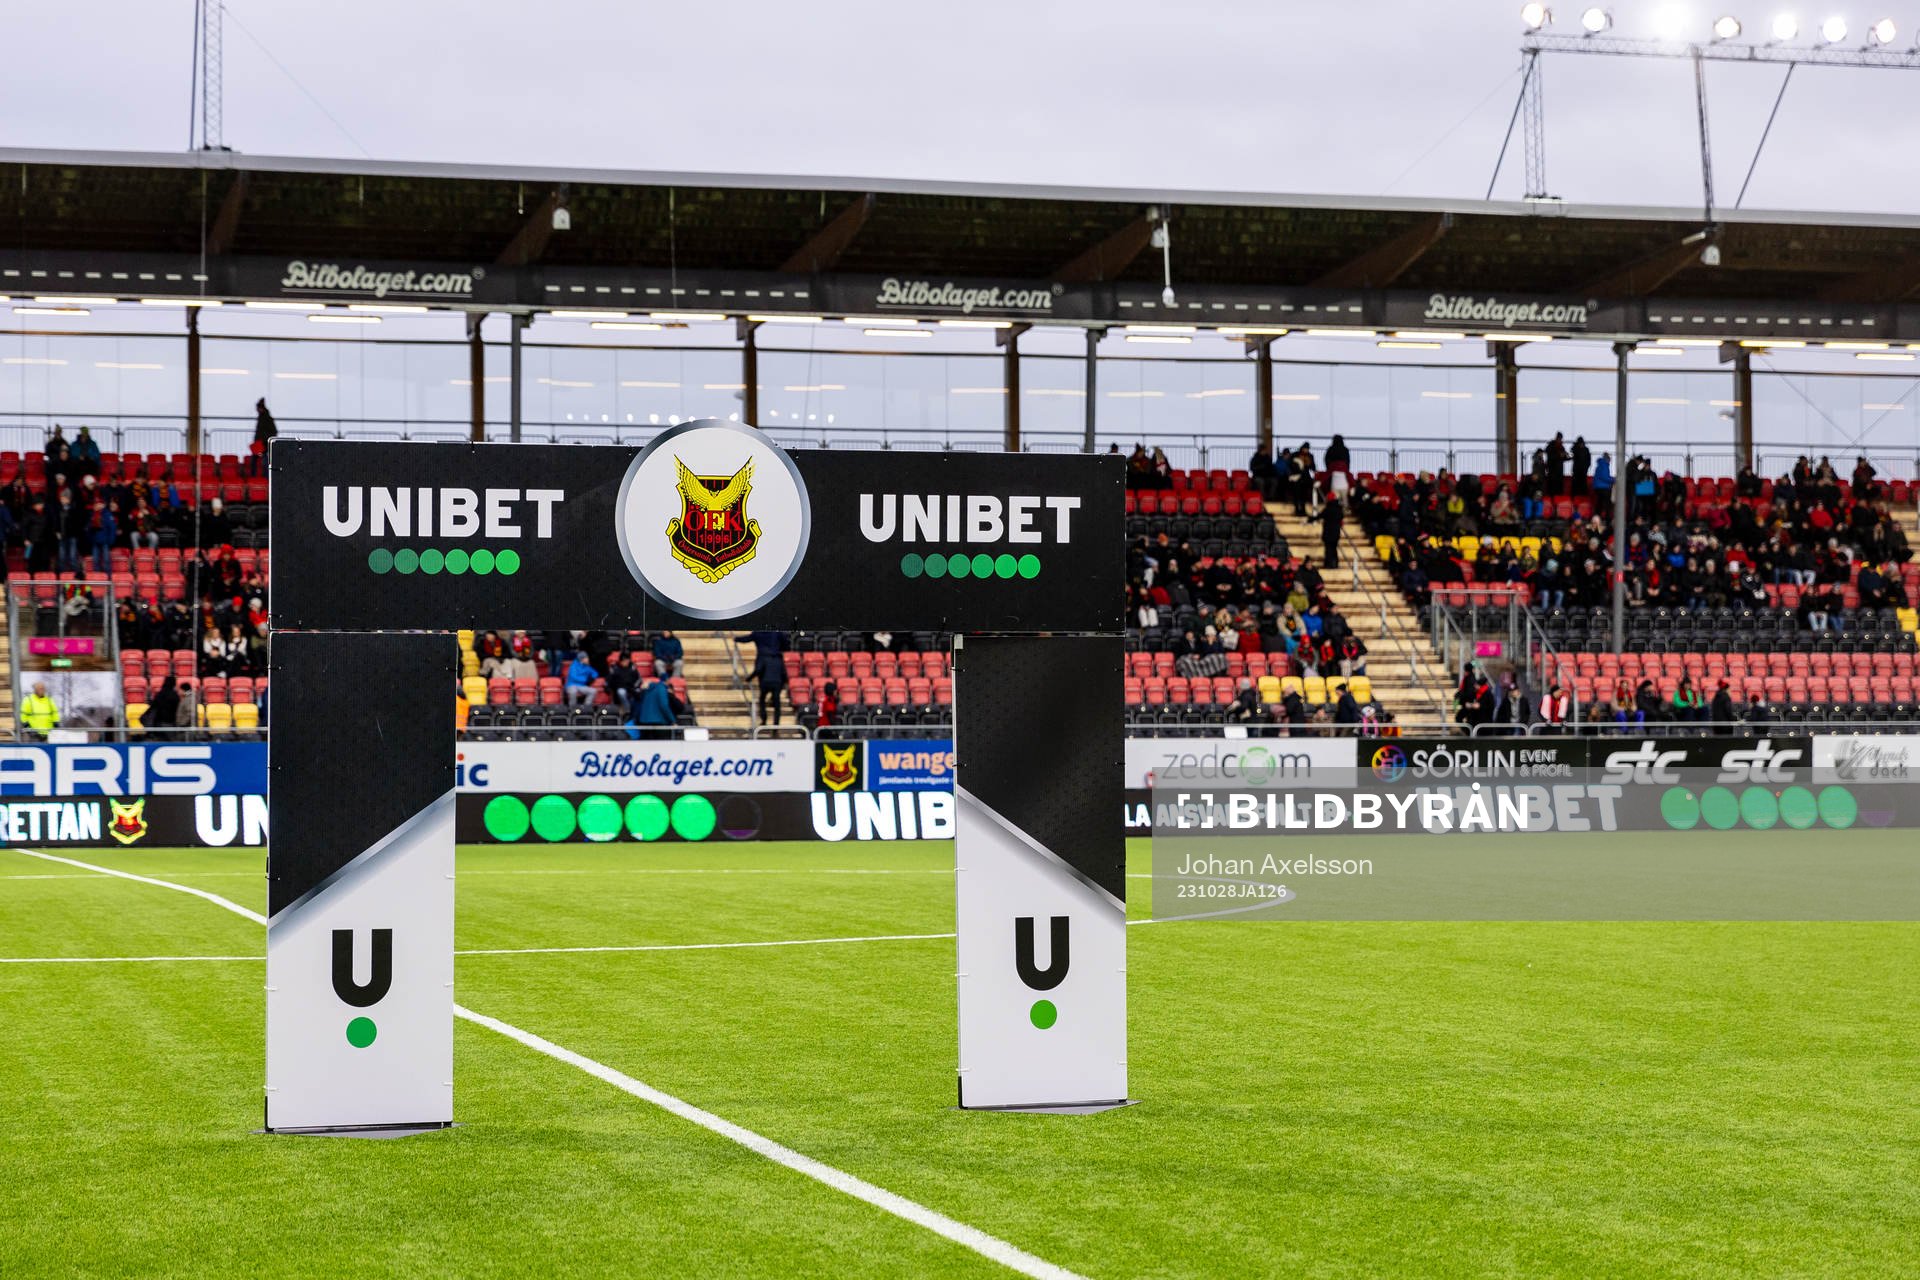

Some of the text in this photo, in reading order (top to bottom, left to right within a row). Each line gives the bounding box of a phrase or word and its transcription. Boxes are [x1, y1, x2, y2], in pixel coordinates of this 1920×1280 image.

[282, 261, 472, 297] Bilbolaget.com
[876, 278, 1052, 313] Bilbolaget.com
[1424, 294, 1587, 328] Bilbolaget.com
[323, 486, 564, 538] UNIBET
[685, 504, 743, 531] ÖFK
[860, 494, 1081, 544] UNIBET
[700, 534, 730, 544] 1996
[0, 746, 217, 796] ARIS
[457, 753, 488, 786] ic
[575, 751, 773, 785] Bilbolaget.com
[1162, 743, 1311, 784] zedcom
[1412, 744, 1515, 778] SÖRLIN
[1519, 763, 1573, 778] & PROFIL
[1520, 749, 1557, 763] EVENT
[1600, 740, 1688, 785] stc
[1716, 739, 1803, 784] stc
[0, 802, 101, 841] RETTAN
[811, 791, 955, 841] UNIB
